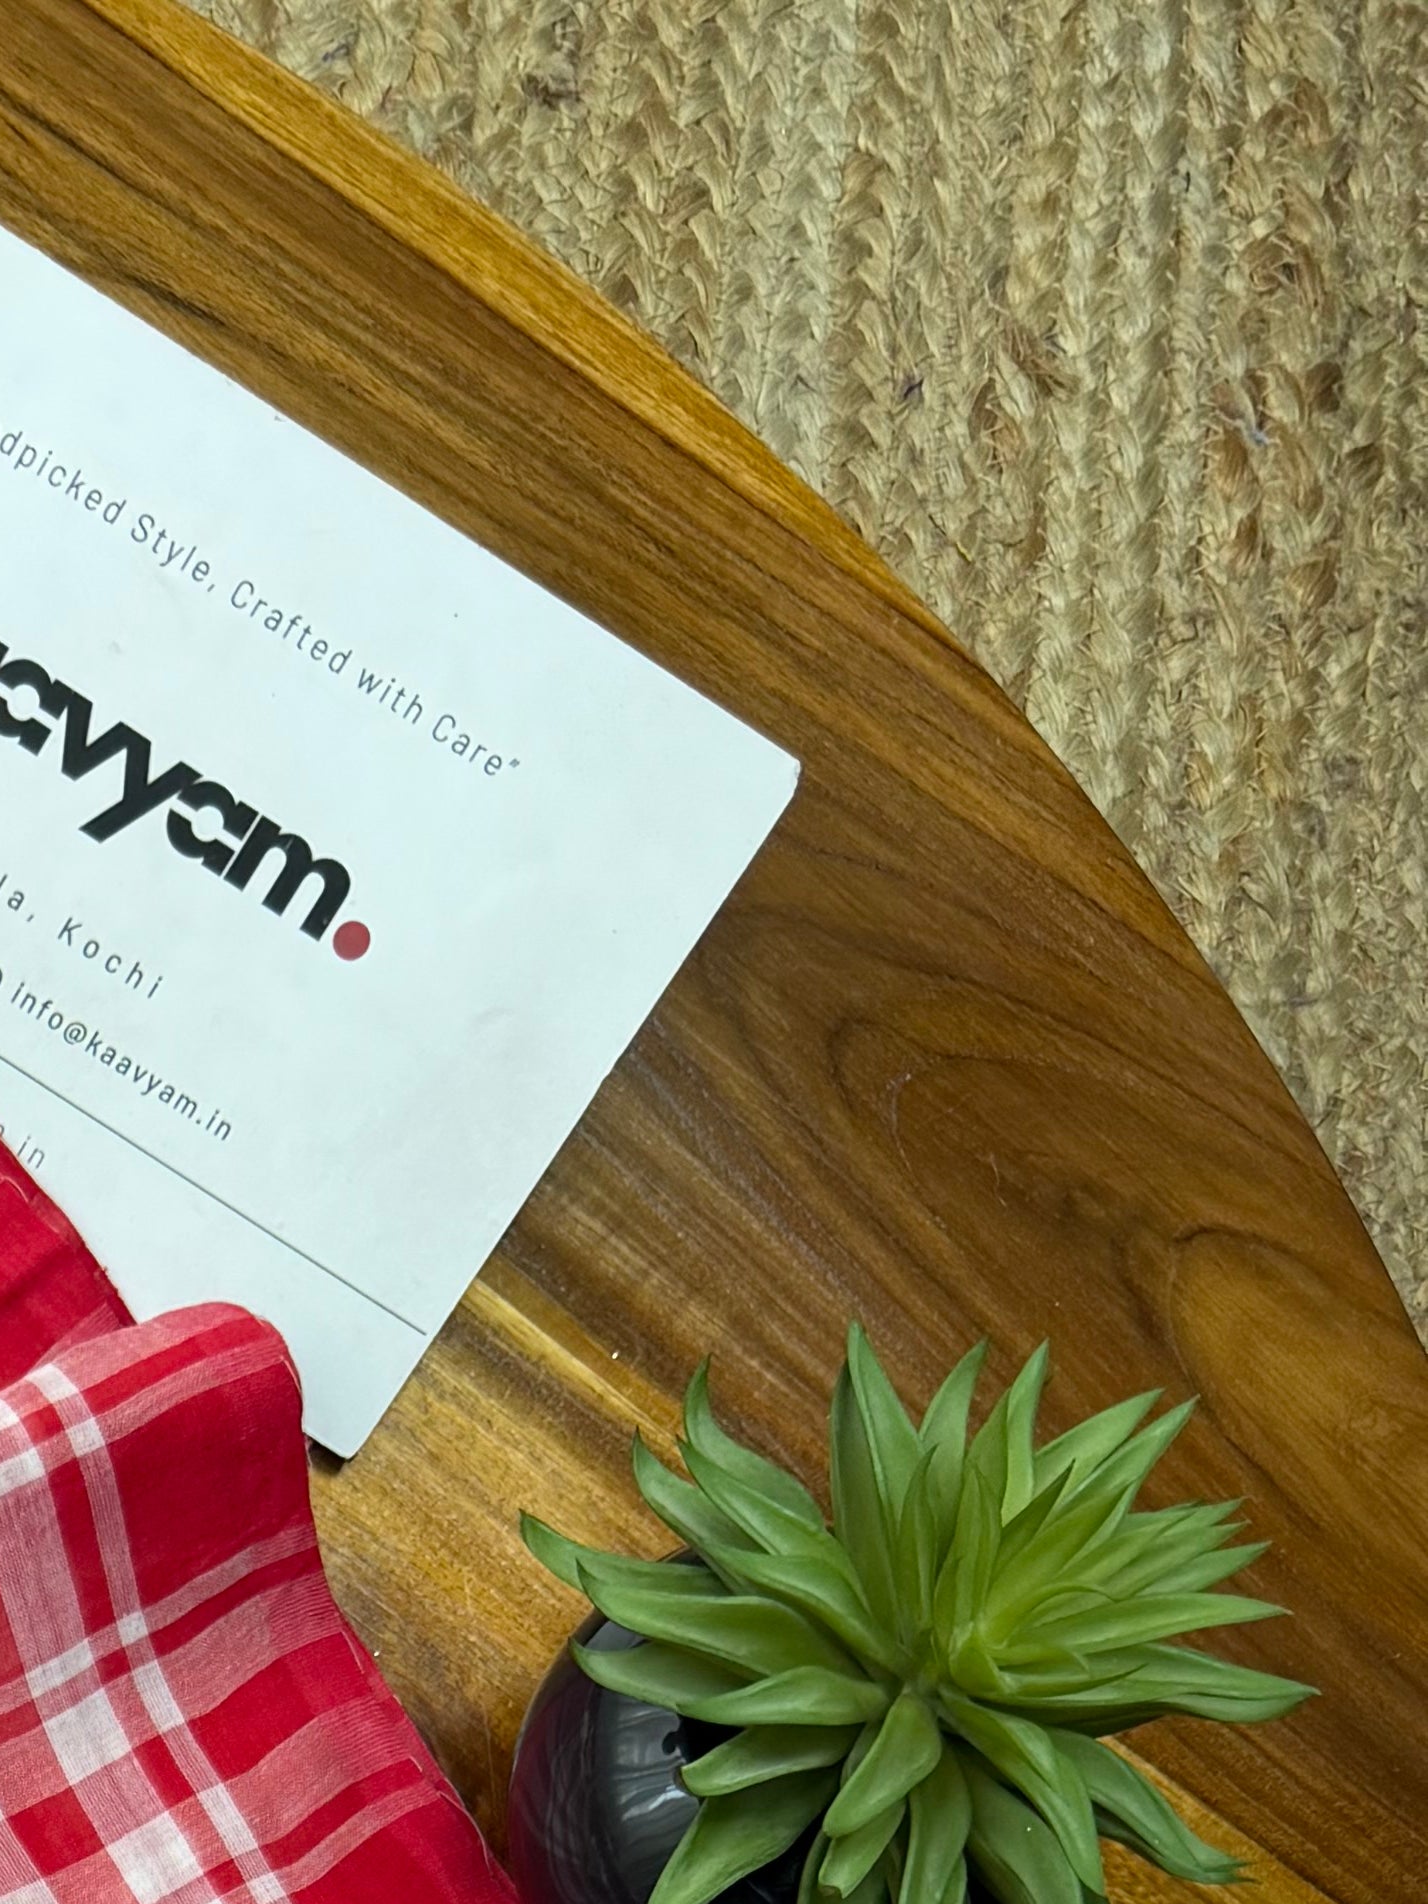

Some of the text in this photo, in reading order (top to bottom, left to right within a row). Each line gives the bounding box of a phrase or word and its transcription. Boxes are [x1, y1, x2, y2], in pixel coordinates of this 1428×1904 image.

[130, 513, 216, 593] Style,
[230, 579, 353, 675] Crafted
[357, 667, 423, 725] with
[57, 916, 164, 999] Kochi
[10, 981, 232, 1142] info@kaavyam.in
